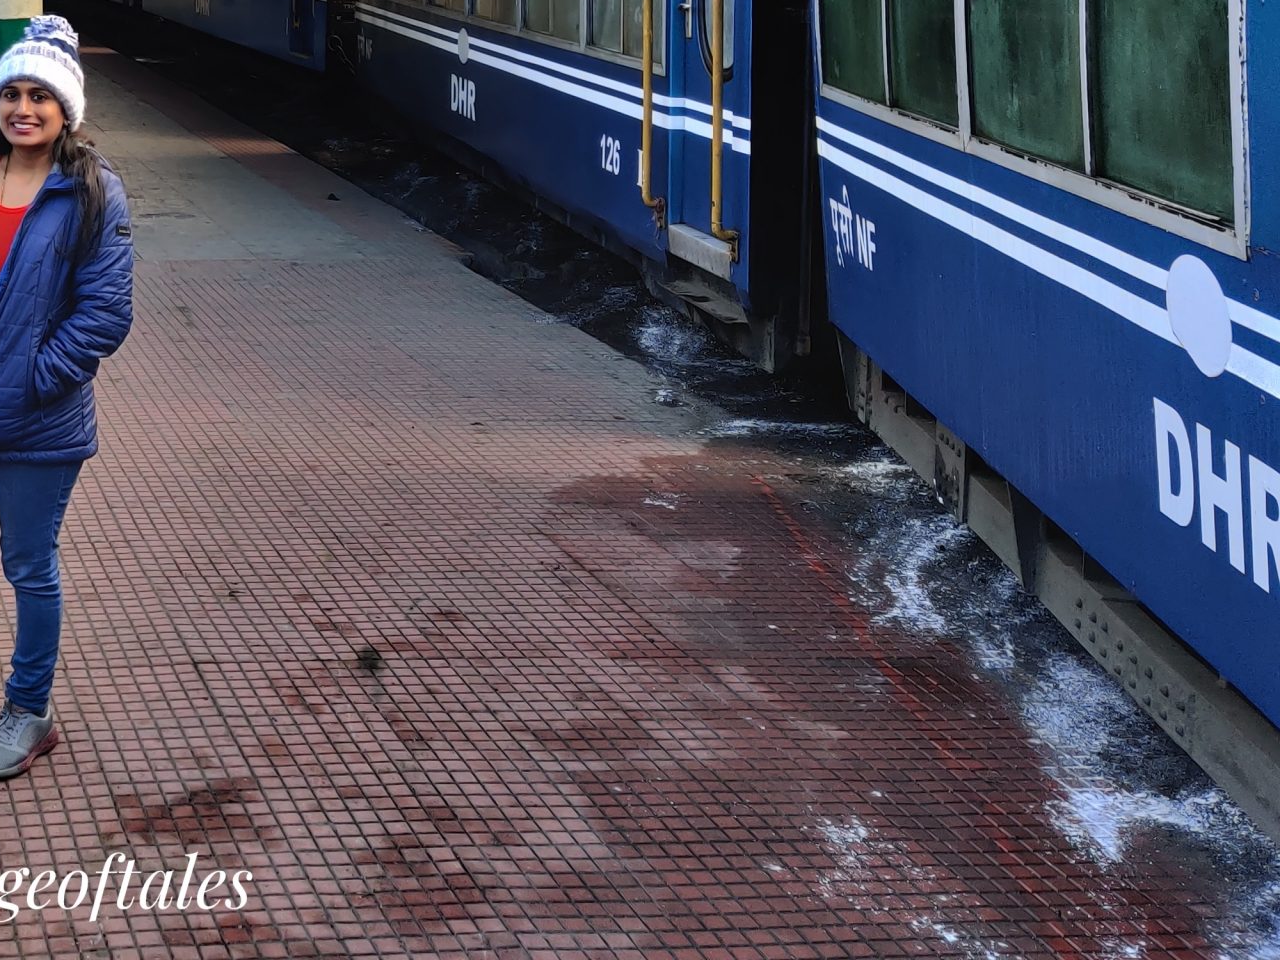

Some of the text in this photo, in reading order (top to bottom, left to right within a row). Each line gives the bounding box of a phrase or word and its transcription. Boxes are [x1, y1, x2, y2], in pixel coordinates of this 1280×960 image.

[450, 73, 476, 122] DHR
[600, 133, 621, 176] 126
[856, 213, 876, 272] NF
[1153, 396, 1280, 593] DHR
